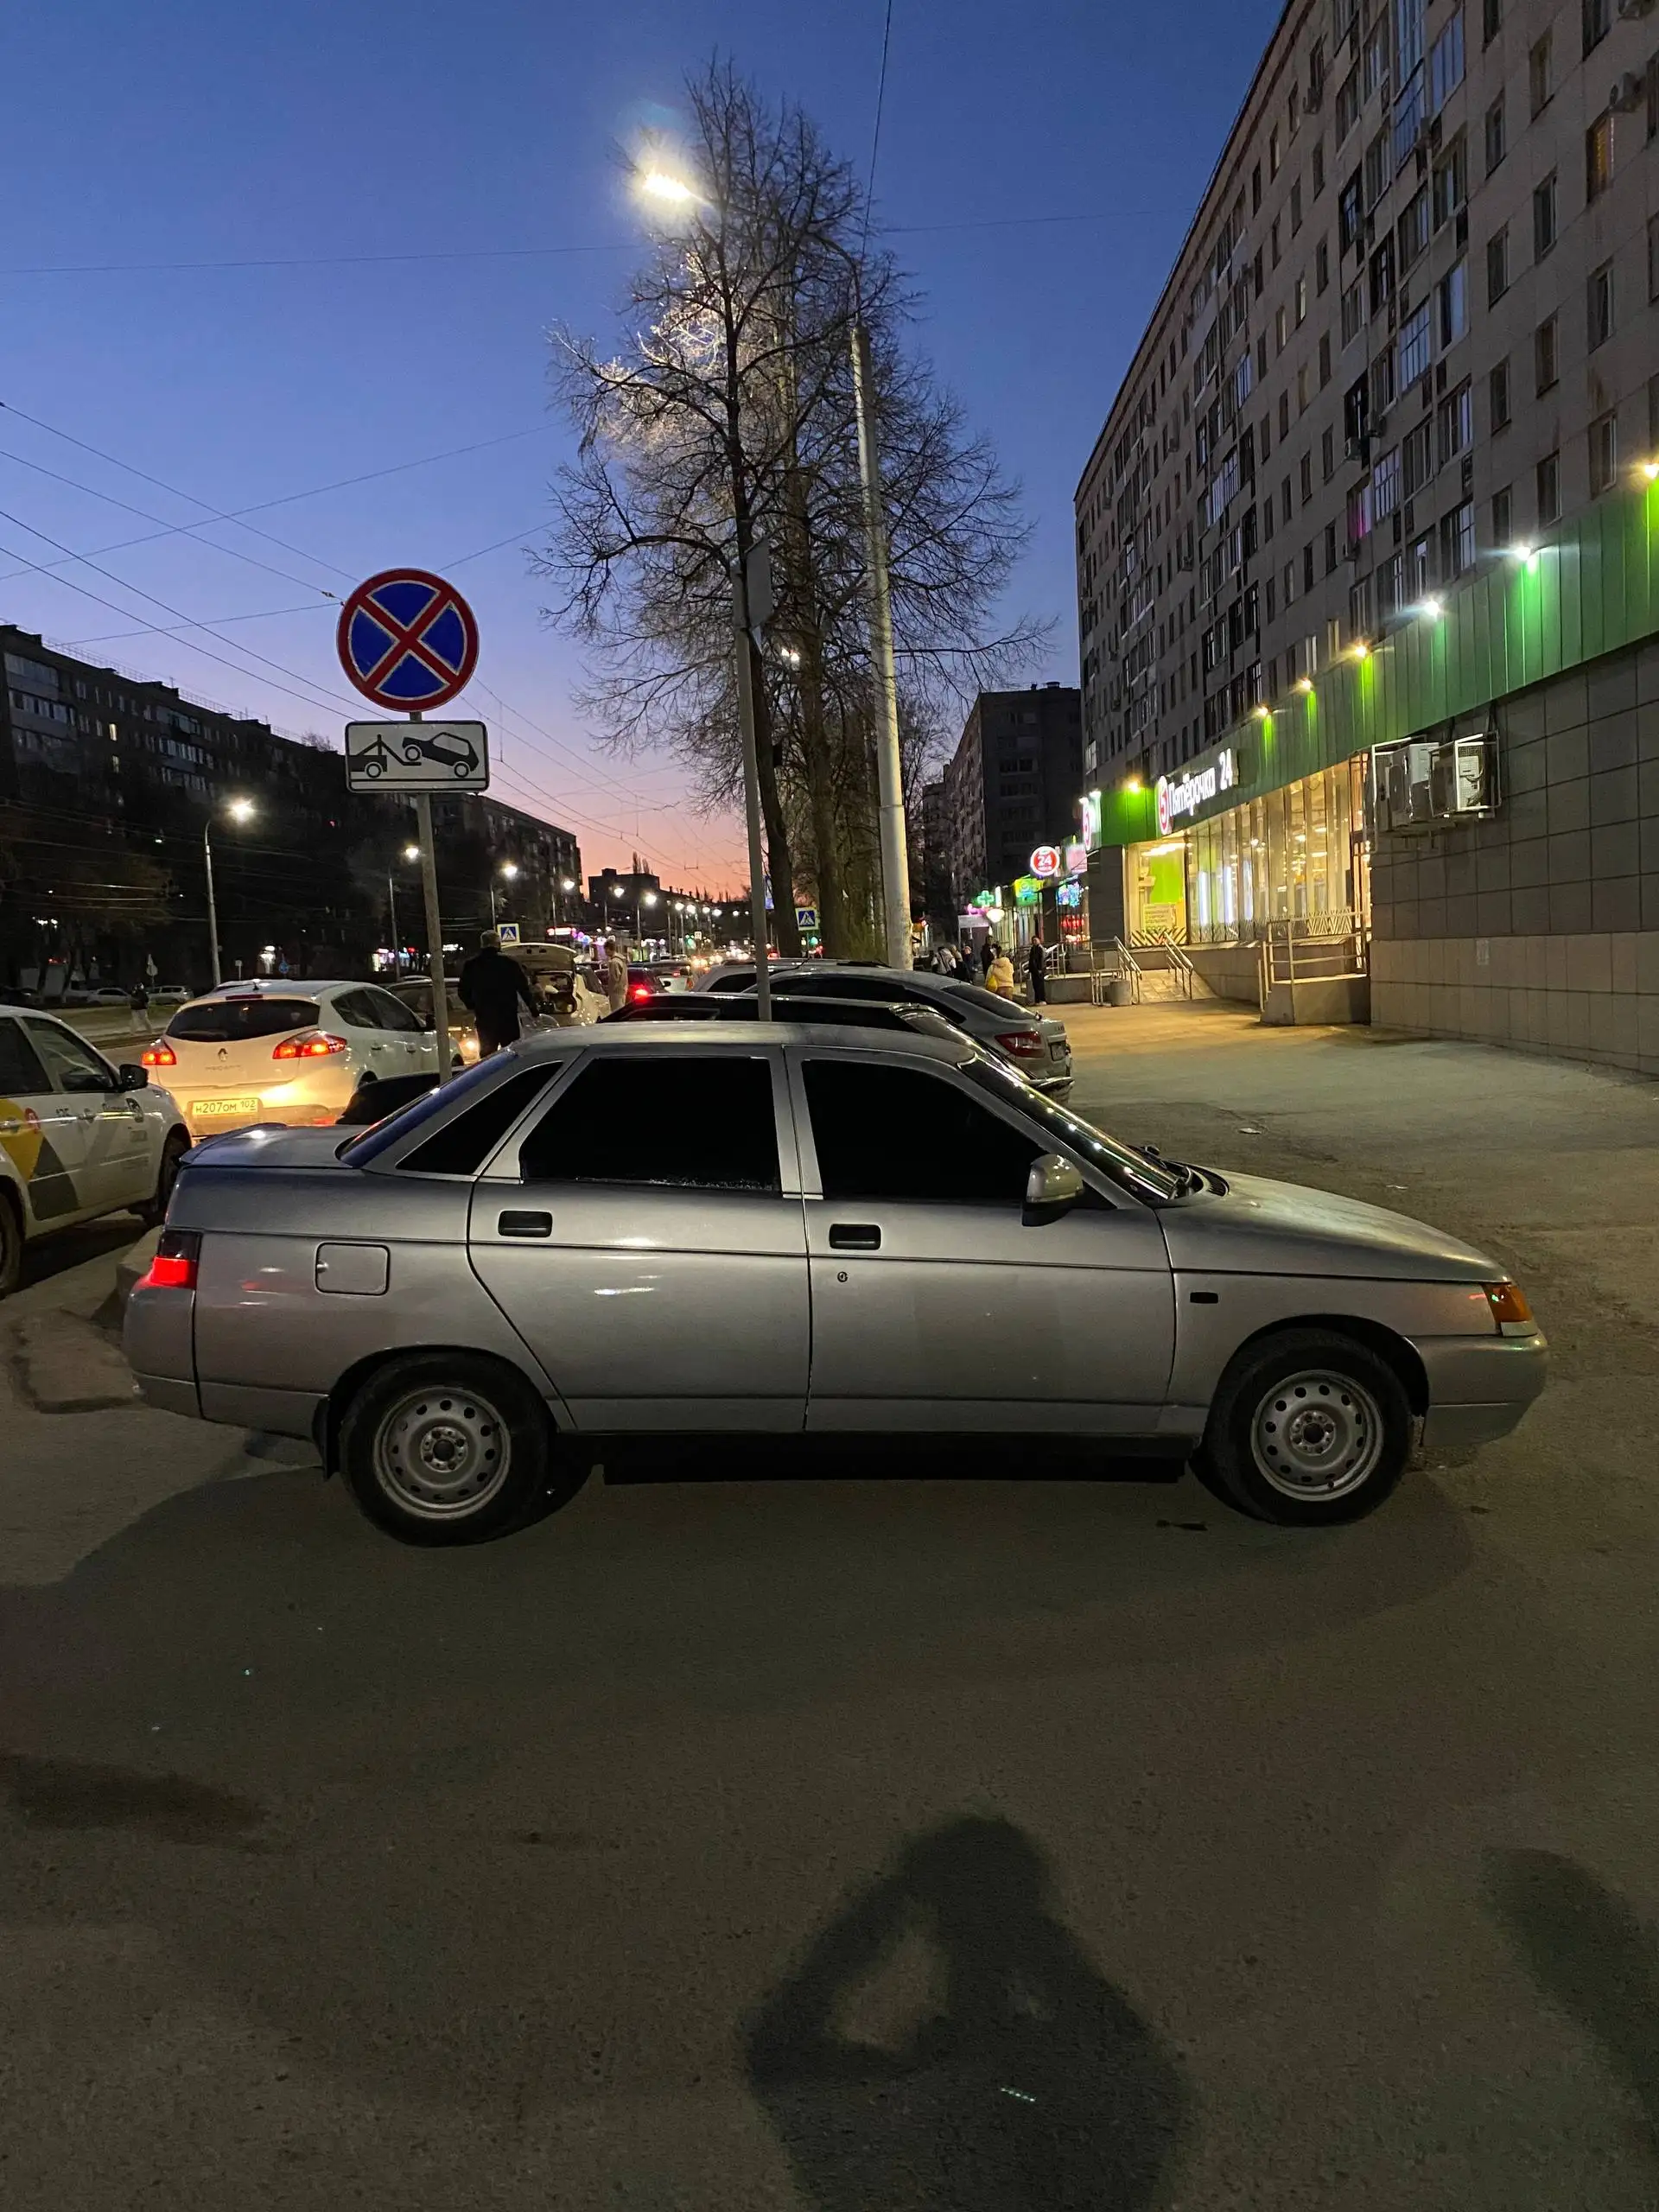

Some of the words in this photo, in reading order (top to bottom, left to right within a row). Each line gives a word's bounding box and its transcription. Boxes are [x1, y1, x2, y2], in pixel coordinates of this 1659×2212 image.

[1168, 767, 1216, 816] Пятёрочка
[1219, 748, 1233, 790] 24
[1037, 855, 1052, 867] 24
